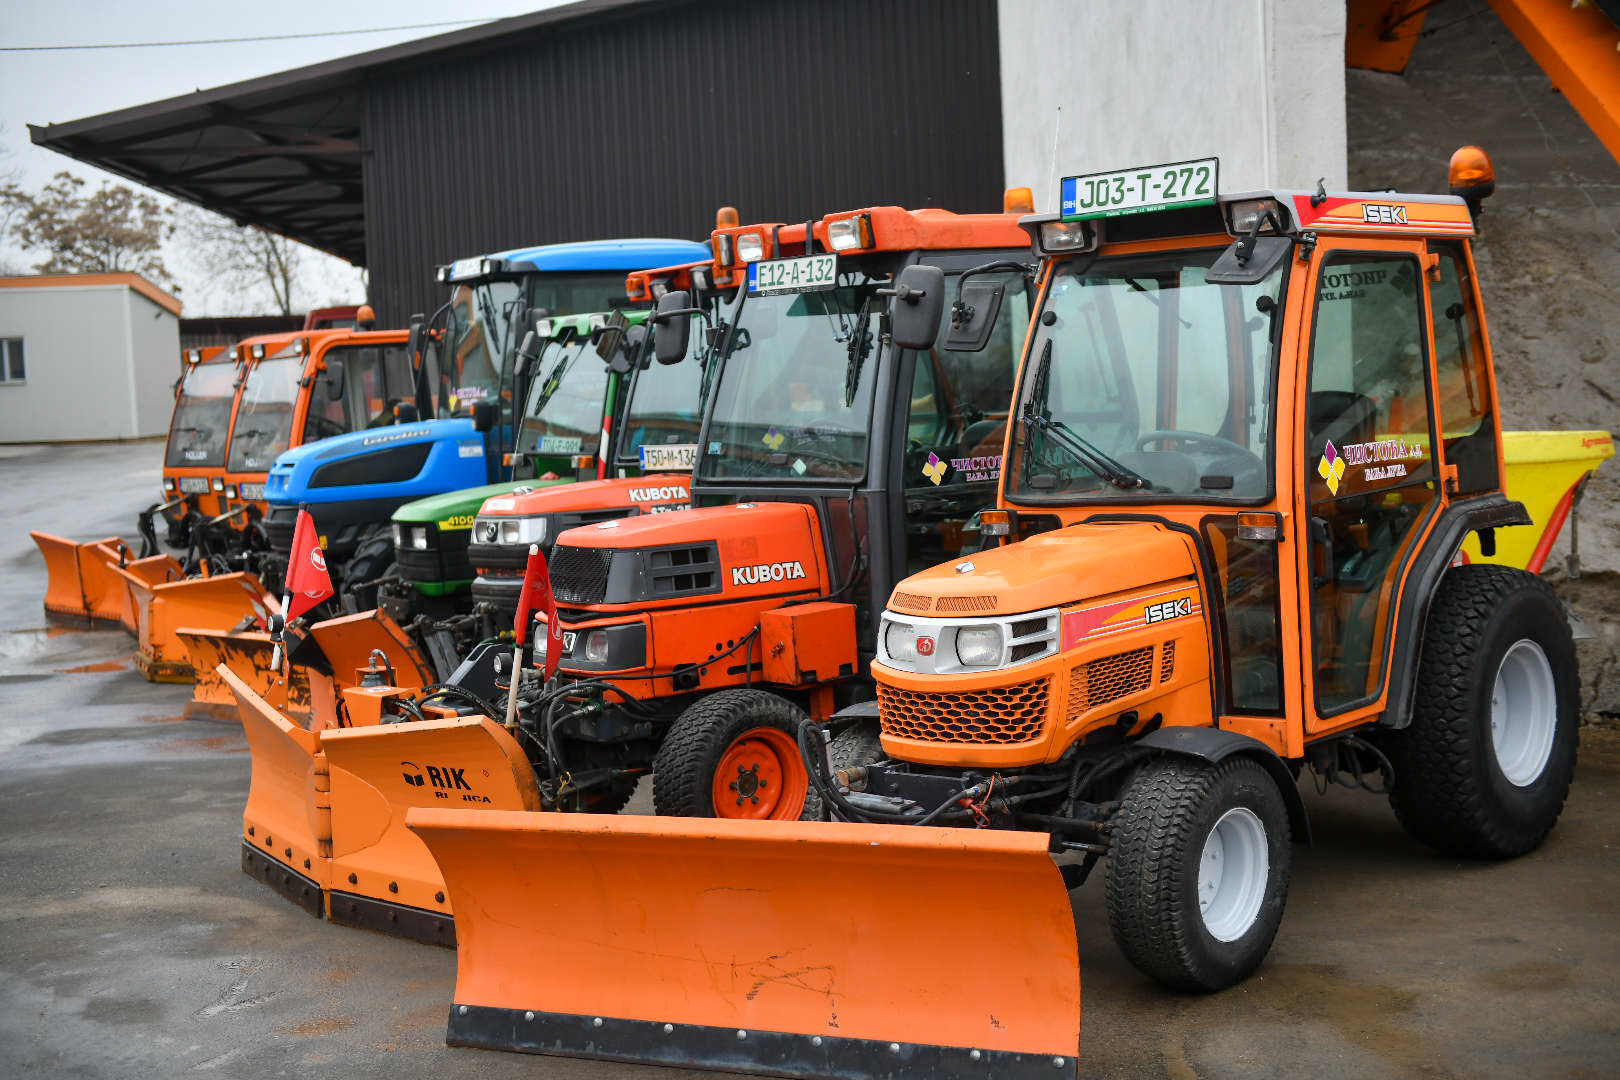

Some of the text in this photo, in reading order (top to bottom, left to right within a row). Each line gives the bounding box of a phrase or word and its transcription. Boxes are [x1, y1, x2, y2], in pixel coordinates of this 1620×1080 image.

[1063, 166, 1210, 209] BIH J03-T-272
[1361, 203, 1409, 225] ISEKI
[759, 258, 833, 287] E12-A-132
[645, 448, 697, 466] T50-M-136
[1342, 439, 1408, 466] ЧИСТОЋА
[628, 485, 689, 503] KUBOTA
[448, 515, 475, 526] 4100
[732, 561, 806, 586] KUBOTA
[1144, 597, 1193, 625] ISEKI
